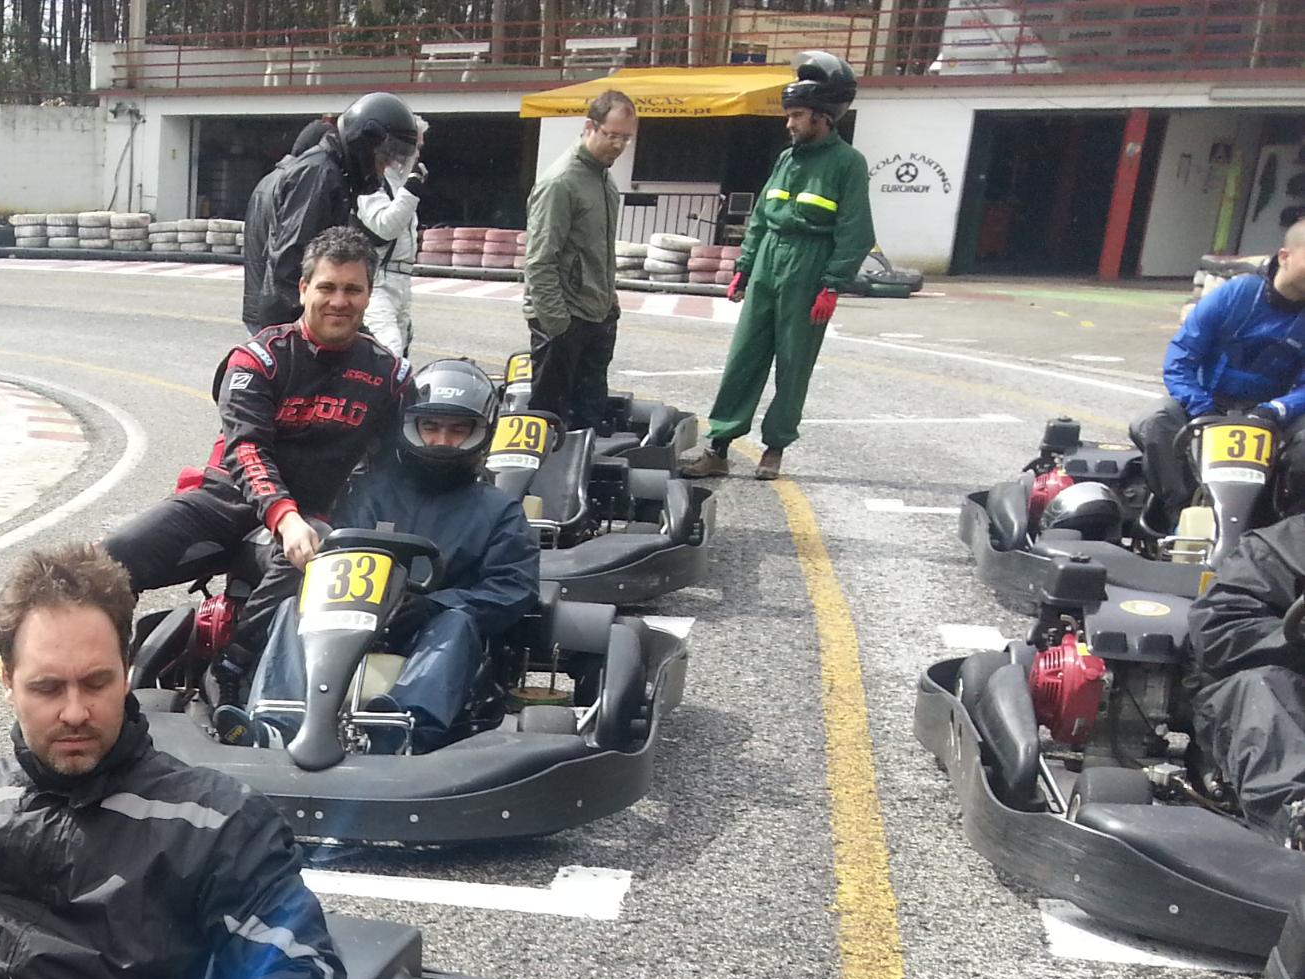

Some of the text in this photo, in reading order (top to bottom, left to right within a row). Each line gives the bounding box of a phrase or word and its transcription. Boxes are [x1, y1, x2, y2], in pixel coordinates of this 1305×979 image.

[868, 153, 951, 194] COLA KARTING
[881, 184, 930, 193] EUROINDY
[434, 386, 465, 398] agv
[506, 417, 541, 450] 29
[1227, 429, 1265, 461] 31
[327, 555, 376, 601] 33
